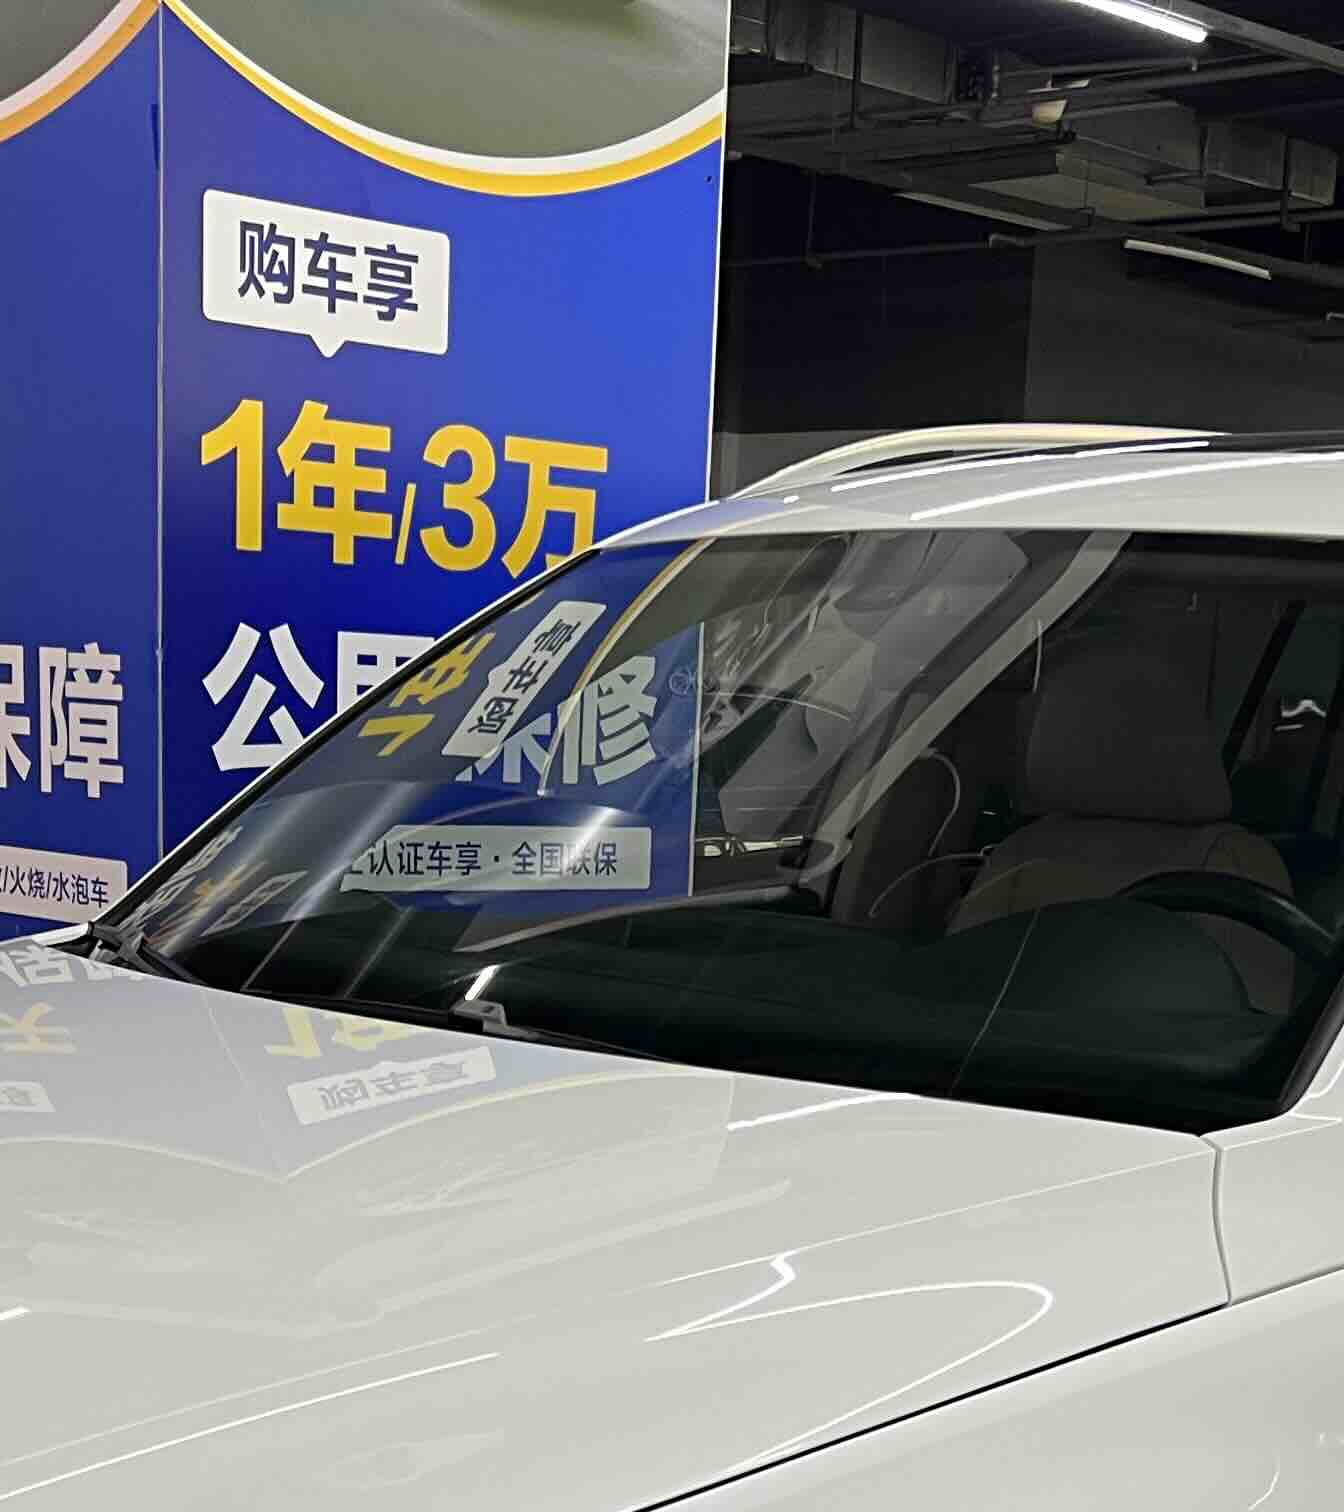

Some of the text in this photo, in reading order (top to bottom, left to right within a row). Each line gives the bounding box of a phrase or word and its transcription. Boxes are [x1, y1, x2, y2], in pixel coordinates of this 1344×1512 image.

[238, 220, 420, 322] 购车享
[200, 399, 609, 579] 1年/3万
